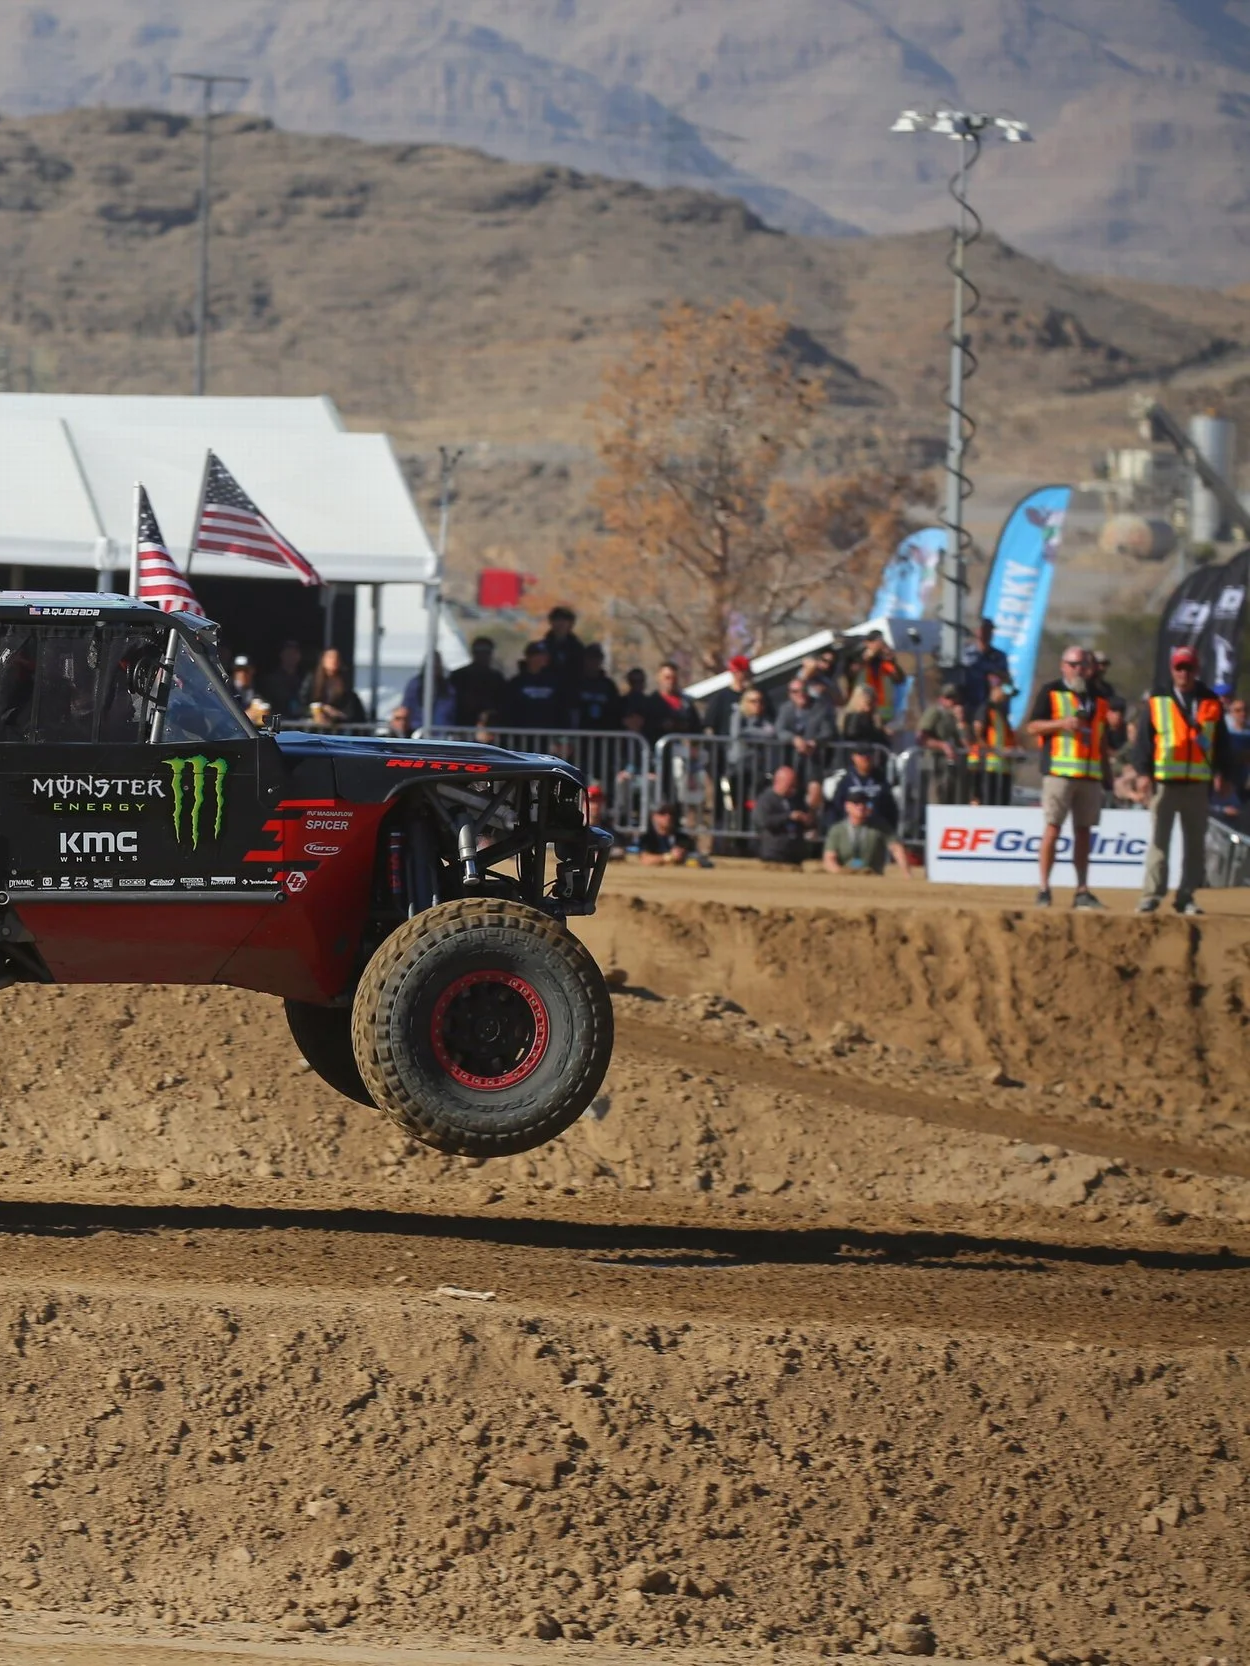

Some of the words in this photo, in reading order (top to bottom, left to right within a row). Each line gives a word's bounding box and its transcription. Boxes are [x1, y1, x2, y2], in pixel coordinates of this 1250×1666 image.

[32, 775, 166, 798] MONSTER
[53, 803, 145, 811] ENERGY
[305, 820, 349, 830] SPICER
[59, 831, 138, 854] KMC
[939, 827, 1148, 856] BFGooric
